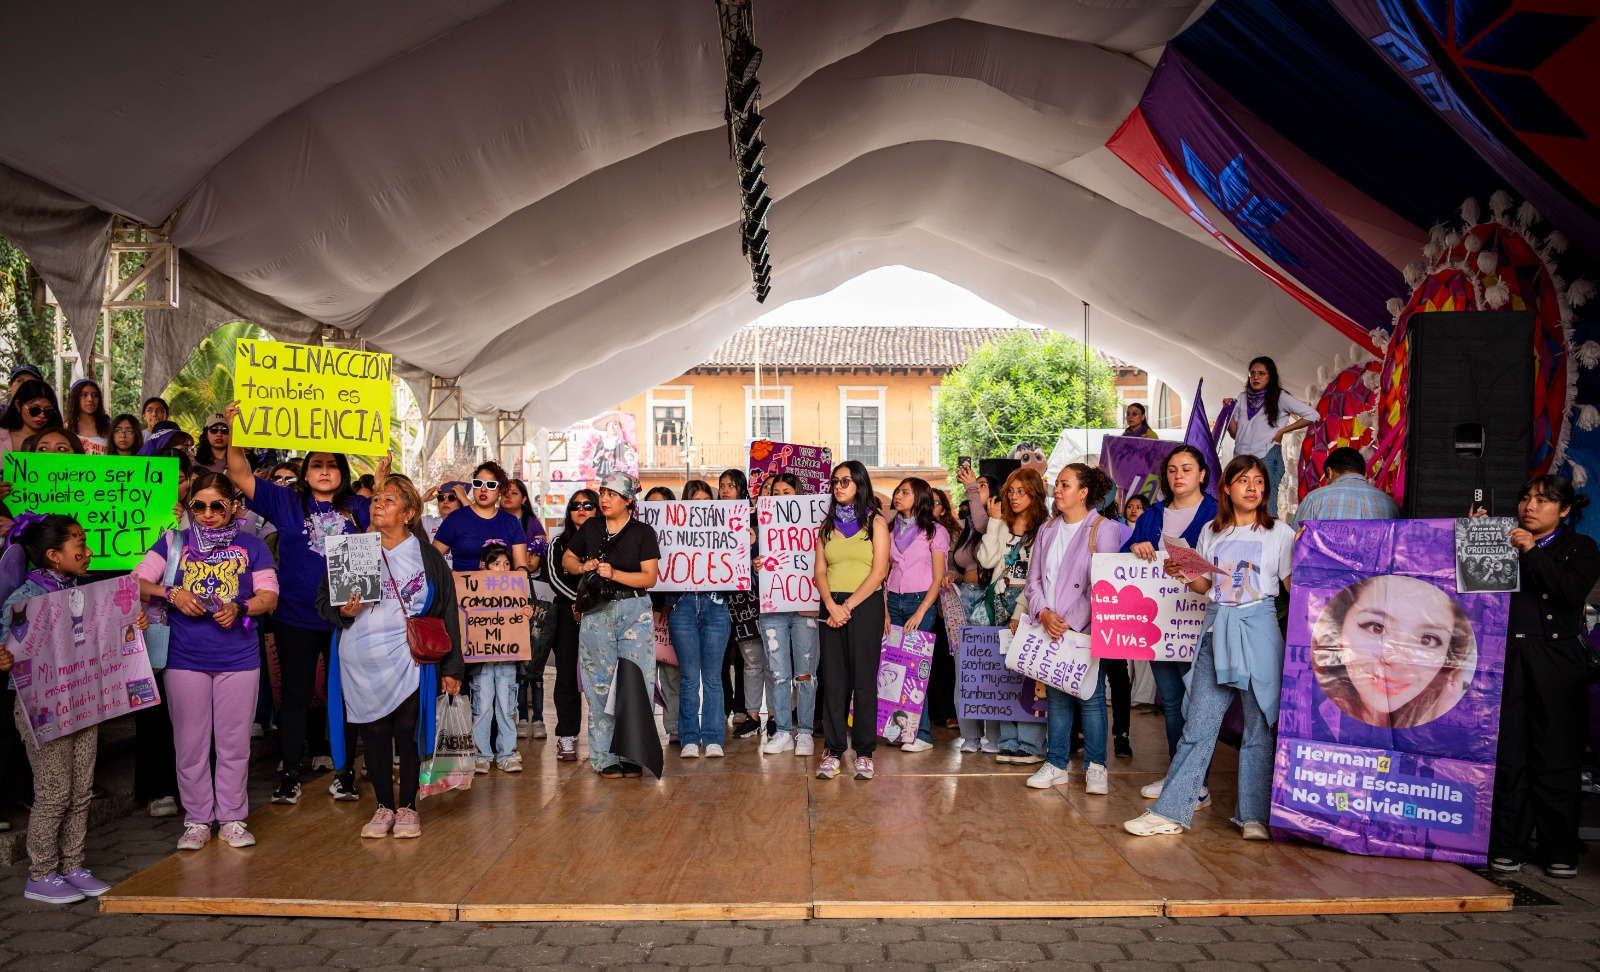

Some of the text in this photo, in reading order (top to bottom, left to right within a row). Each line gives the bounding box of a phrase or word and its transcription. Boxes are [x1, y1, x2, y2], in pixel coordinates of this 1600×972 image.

[282, 345, 391, 381] INACCIÓN
[241, 376, 361, 404] también es
[237, 406, 384, 444] VIOLENCIA
[48, 467, 96, 491] quiero
[104, 468, 136, 483] ser
[145, 461, 163, 484] la
[93, 483, 153, 508] estoy
[87, 506, 145, 529] exijo
[636, 503, 725, 528] HOY NO ESTÁN
[776, 500, 829, 524] NO ES
[677, 531, 738, 550] NUESTRAS
[1469, 531, 1506, 541] FIESTA,
[1467, 546, 1507, 554] PROTESTA!
[794, 555, 809, 571] ES
[1114, 565, 1176, 581] QUERE
[484, 574, 525, 593] #8M
[1159, 584, 1179, 598] que
[460, 596, 527, 609] COMODIDAD
[1095, 593, 1119, 604] Las
[1175, 599, 1208, 613] Niña
[467, 611, 523, 627] epende de
[1096, 612, 1149, 624] queremos
[485, 628, 501, 641] MI
[966, 645, 992, 657] idea
[38, 662, 53, 684] Mi
[58, 655, 86, 676] mamá
[88, 656, 99, 667] me
[101, 645, 118, 662] está
[961, 658, 1001, 672] sostiene
[45, 670, 93, 699] enseñando
[961, 671, 1023, 687] las mujeres
[100, 687, 110, 697] no
[111, 681, 123, 693] me
[960, 685, 996, 700] tambien
[963, 703, 1013, 718] personas
[57, 719, 74, 731] veo
[76, 708, 92, 722] más
[1296, 745, 1390, 772] Hermana
[1294, 766, 1463, 803] Ingrid Escamilla
[1292, 788, 1321, 805] No
[1325, 792, 1348, 810] te
[1352, 796, 1463, 825] olvidamos
